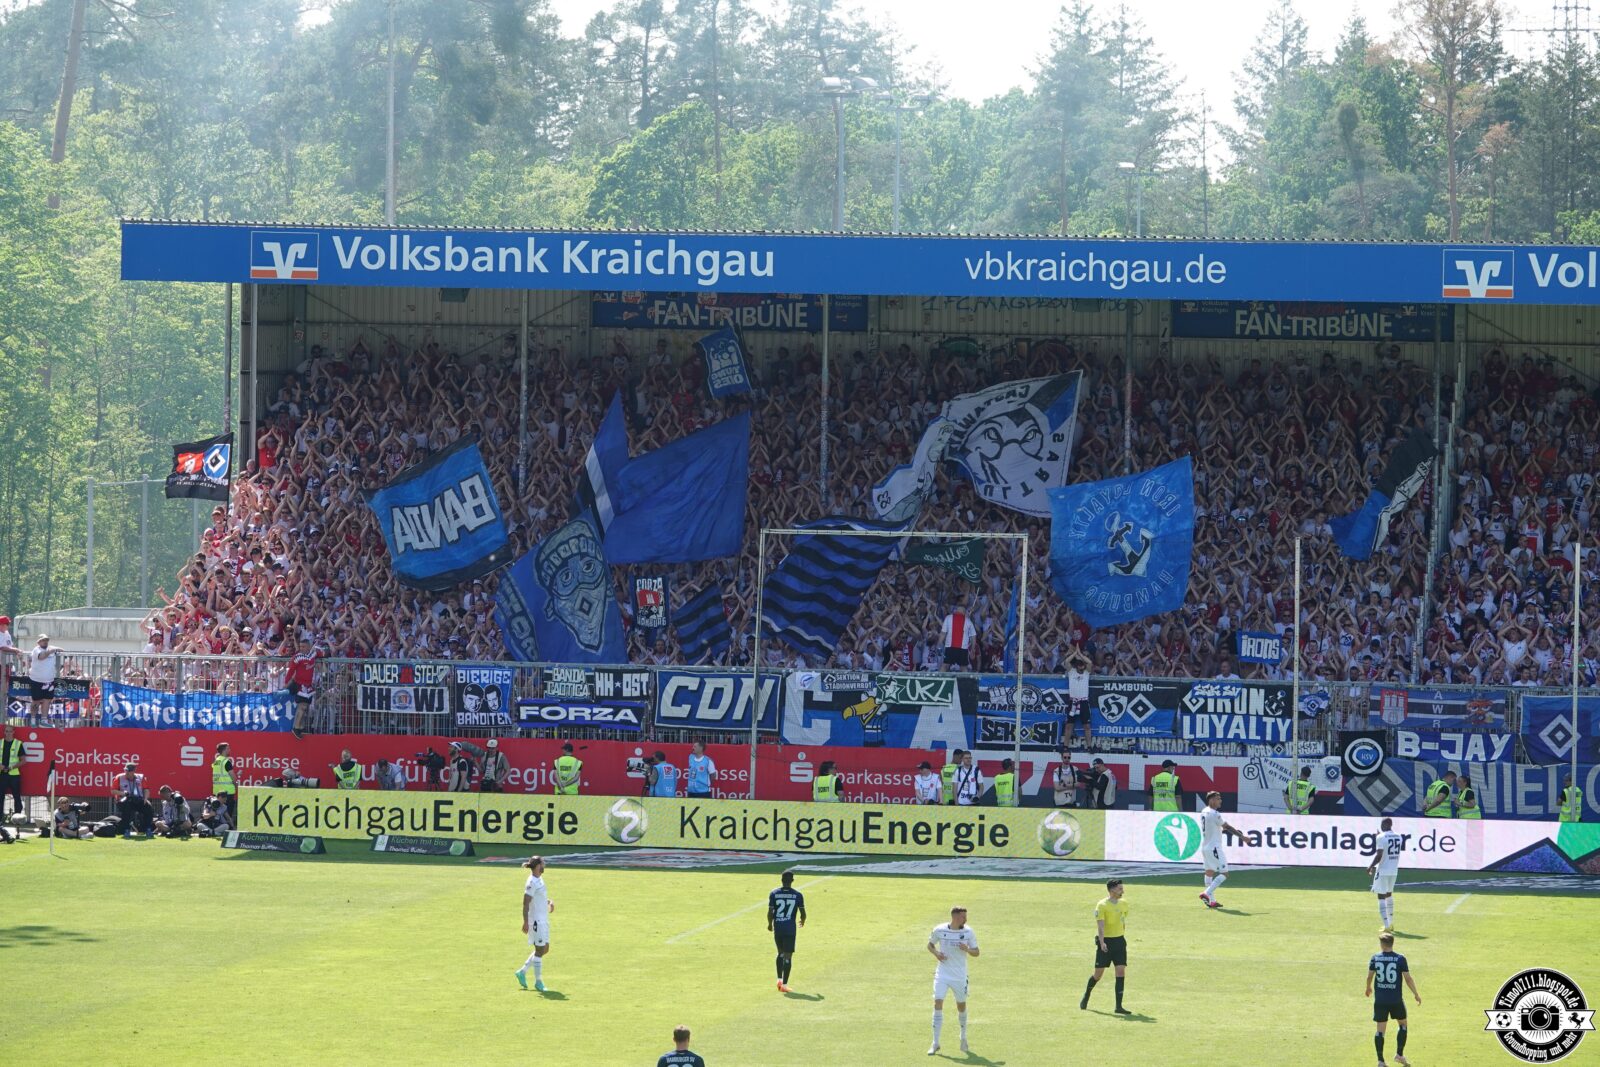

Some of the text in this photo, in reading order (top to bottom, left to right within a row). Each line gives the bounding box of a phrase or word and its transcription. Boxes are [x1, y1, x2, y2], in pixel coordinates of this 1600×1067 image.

[332, 236, 774, 285] Volksbank Kraichgau
[964, 251, 1227, 290] vbkraichgau.de
[653, 299, 808, 329] FAN-TRIBÜNE
[1235, 308, 1393, 338] FAN-TRIBÜNE
[364, 664, 399, 684] DAUER
[457, 669, 512, 684] BIERIGE
[595, 672, 650, 697] HH OST
[1103, 682, 1154, 692] HAMBURG
[361, 686, 392, 711] HH
[456, 712, 513, 726] BANDITEN
[519, 705, 639, 724] FORZA
[1182, 714, 1292, 743] LOYALTY
[1397, 730, 1512, 762] B-JAY
[54, 749, 140, 766] Sparkasse
[835, 769, 912, 787] parkasse
[1388, 838, 1400, 856] 25
[775, 899, 796, 918] 27
[1375, 962, 1397, 984] 36
